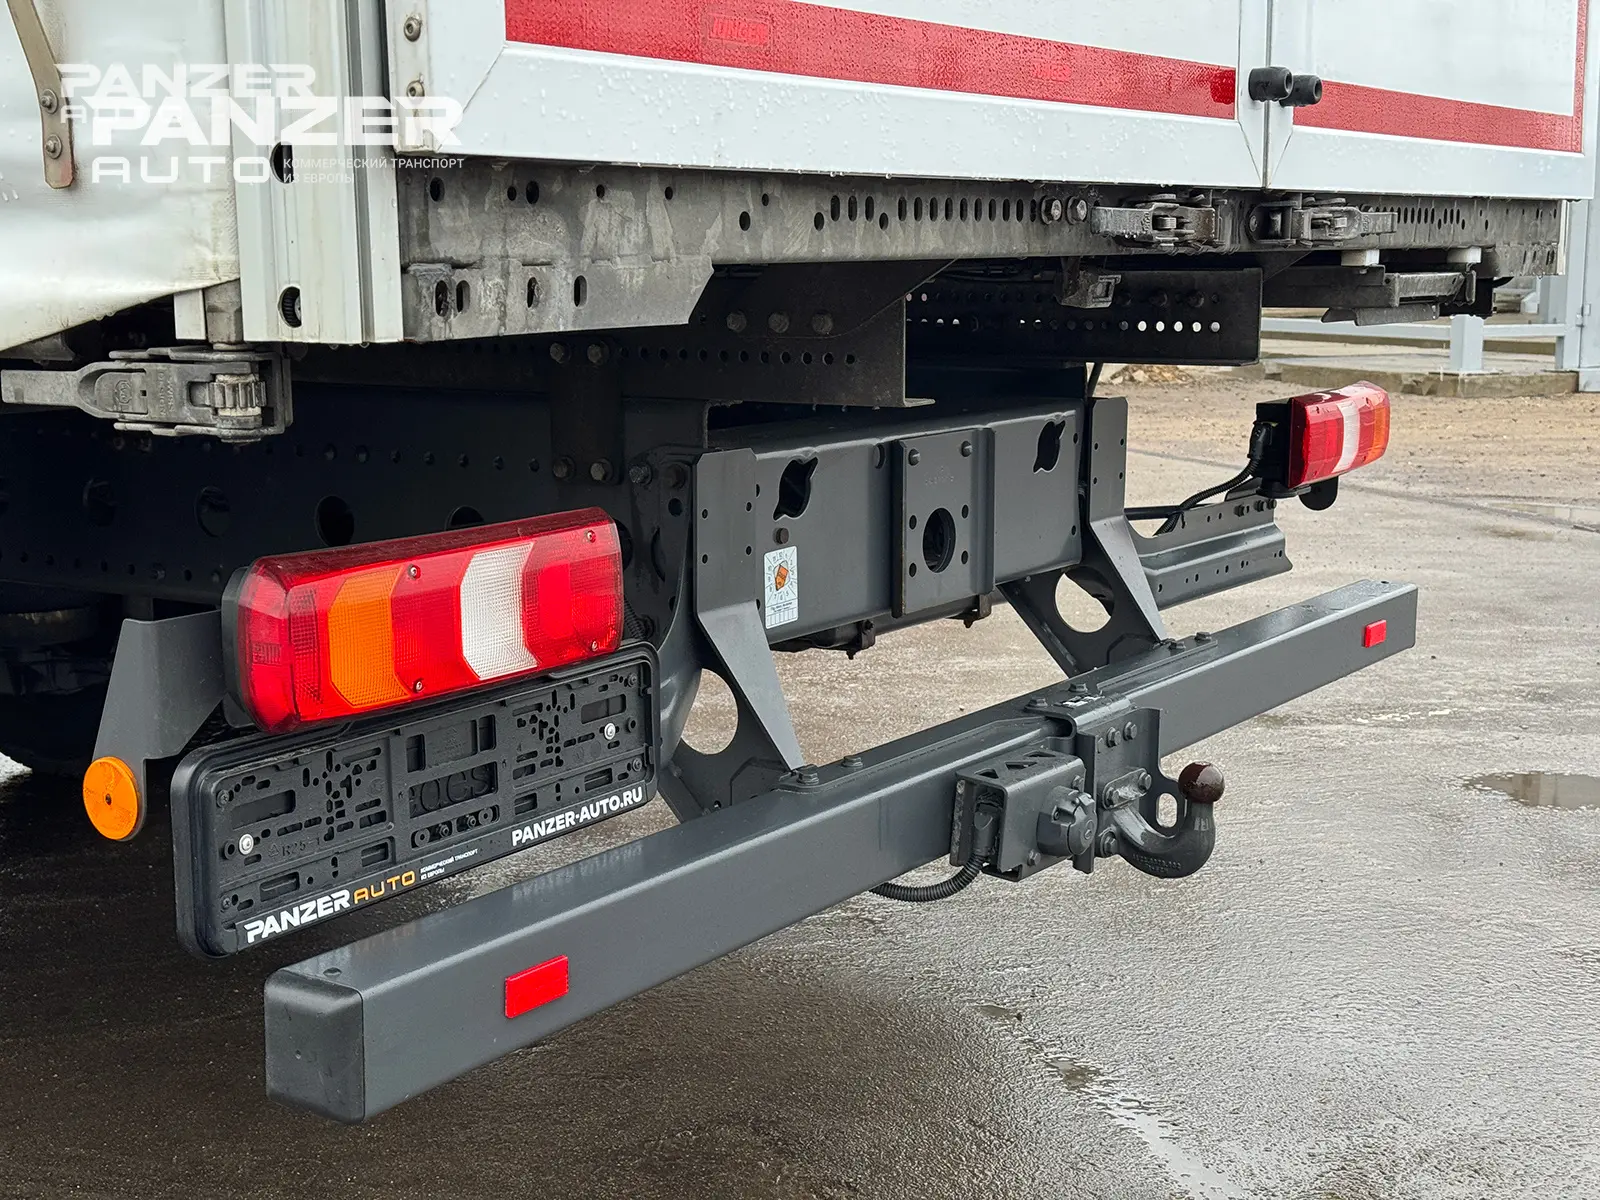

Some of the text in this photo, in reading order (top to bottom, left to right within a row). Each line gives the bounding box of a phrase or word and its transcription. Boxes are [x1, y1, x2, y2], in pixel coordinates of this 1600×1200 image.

[511, 786, 643, 847] PANZER-AUTO.RU
[243, 870, 416, 944] PANZER AUTO
